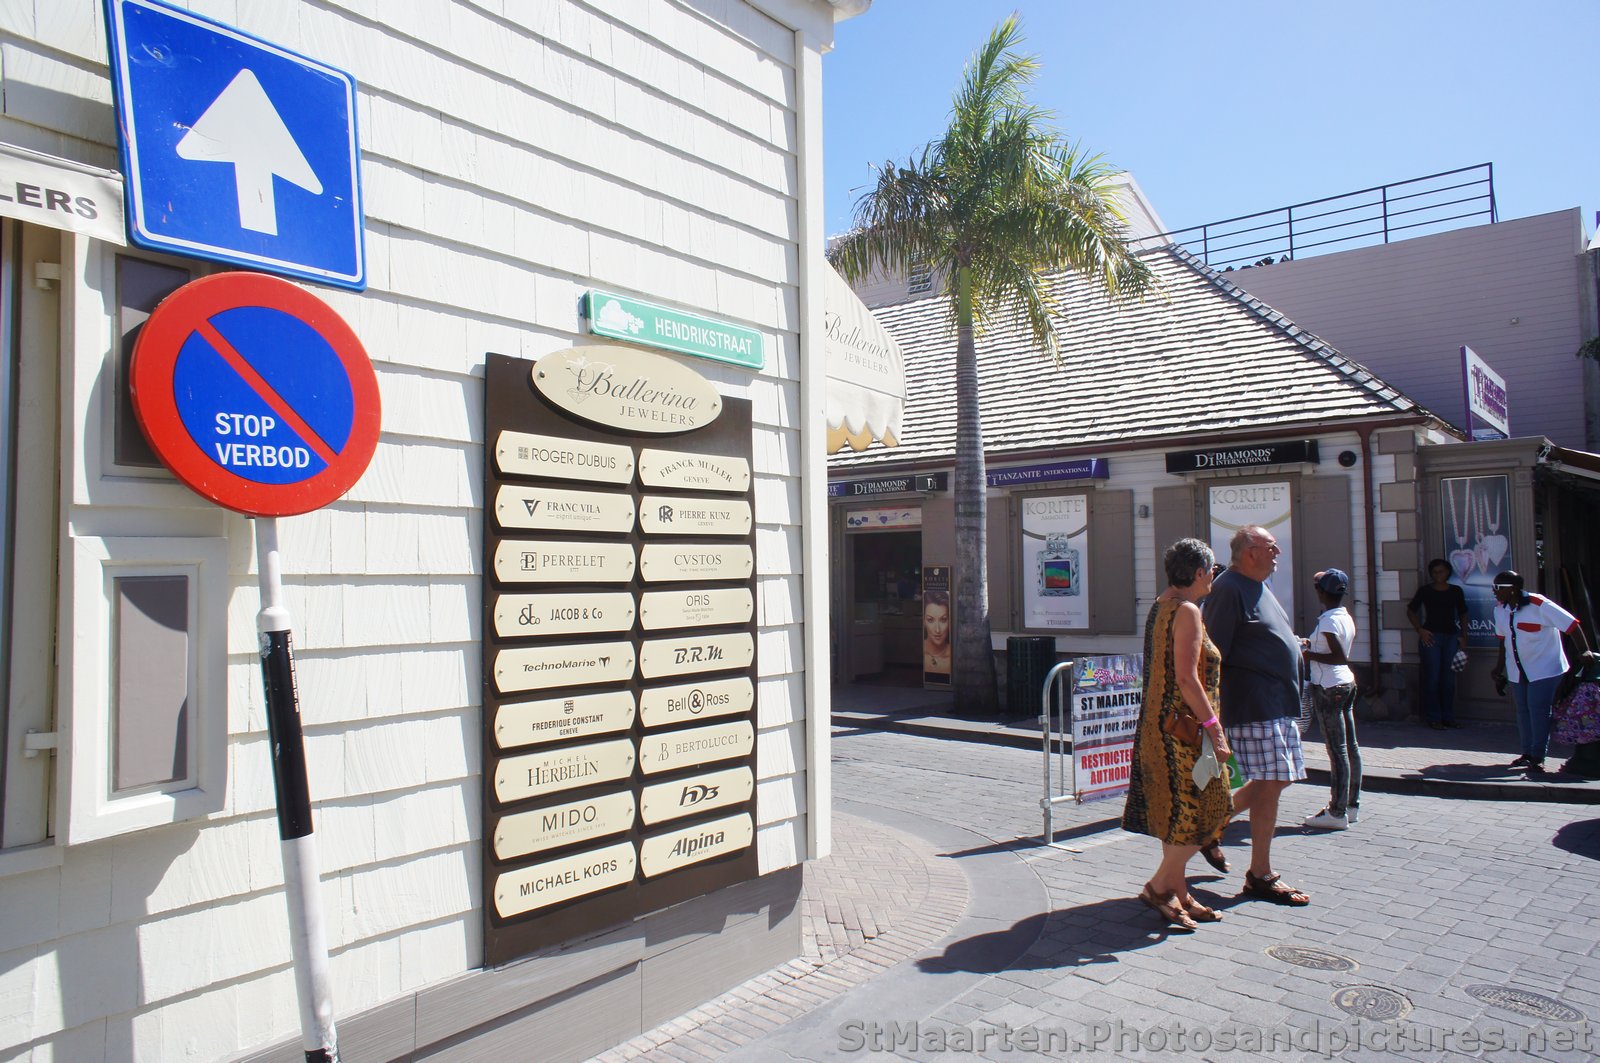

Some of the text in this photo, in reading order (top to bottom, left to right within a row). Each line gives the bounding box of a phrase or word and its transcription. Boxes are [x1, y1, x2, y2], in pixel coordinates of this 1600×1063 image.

[655, 317, 752, 355] HENDRIKSTRAAT
[825, 311, 889, 359] Ballerina
[844, 352, 889, 375] JEWELERS
[578, 363, 698, 410] Ballerina
[215, 412, 276, 437] STOP
[619, 405, 695, 426] JEWELERS
[215, 442, 310, 468] VERBOD
[531, 447, 574, 464] ROGER
[577, 453, 616, 469] DUBUIS
[1215, 457, 1271, 466] INTERNATIONAL
[660, 459, 733, 482] FRANCK MULLER
[998, 466, 1090, 481] TANZANITE INTERNATIONAL
[547, 501, 601, 514] FRANC VILA
[679, 510, 731, 520] PIERRE KUNZ
[543, 554, 605, 567] PERRELET
[674, 554, 722, 566] CVSTOS
[686, 594, 710, 606] ORIS
[550, 607, 603, 621] JACOB & Co
[523, 659, 596, 672] TechnoMarine
[667, 697, 687, 712] Bell
[706, 693, 730, 706] Ross
[1081, 691, 1141, 711] ST MAARTEN
[532, 714, 604, 731] FREDERIQUE CONSTANT
[559, 727, 579, 736] GENEVE
[1083, 724, 1102, 736] ENJOY
[1104, 721, 1120, 733] YOUR
[676, 734, 738, 754] BERTOLUCCI
[543, 754, 587, 767] MICHEL
[1091, 765, 1132, 785] AUTHORI
[542, 805, 597, 833] MIDO
[668, 831, 725, 859] Alpina
[520, 859, 618, 897] MICHAEL KORS
